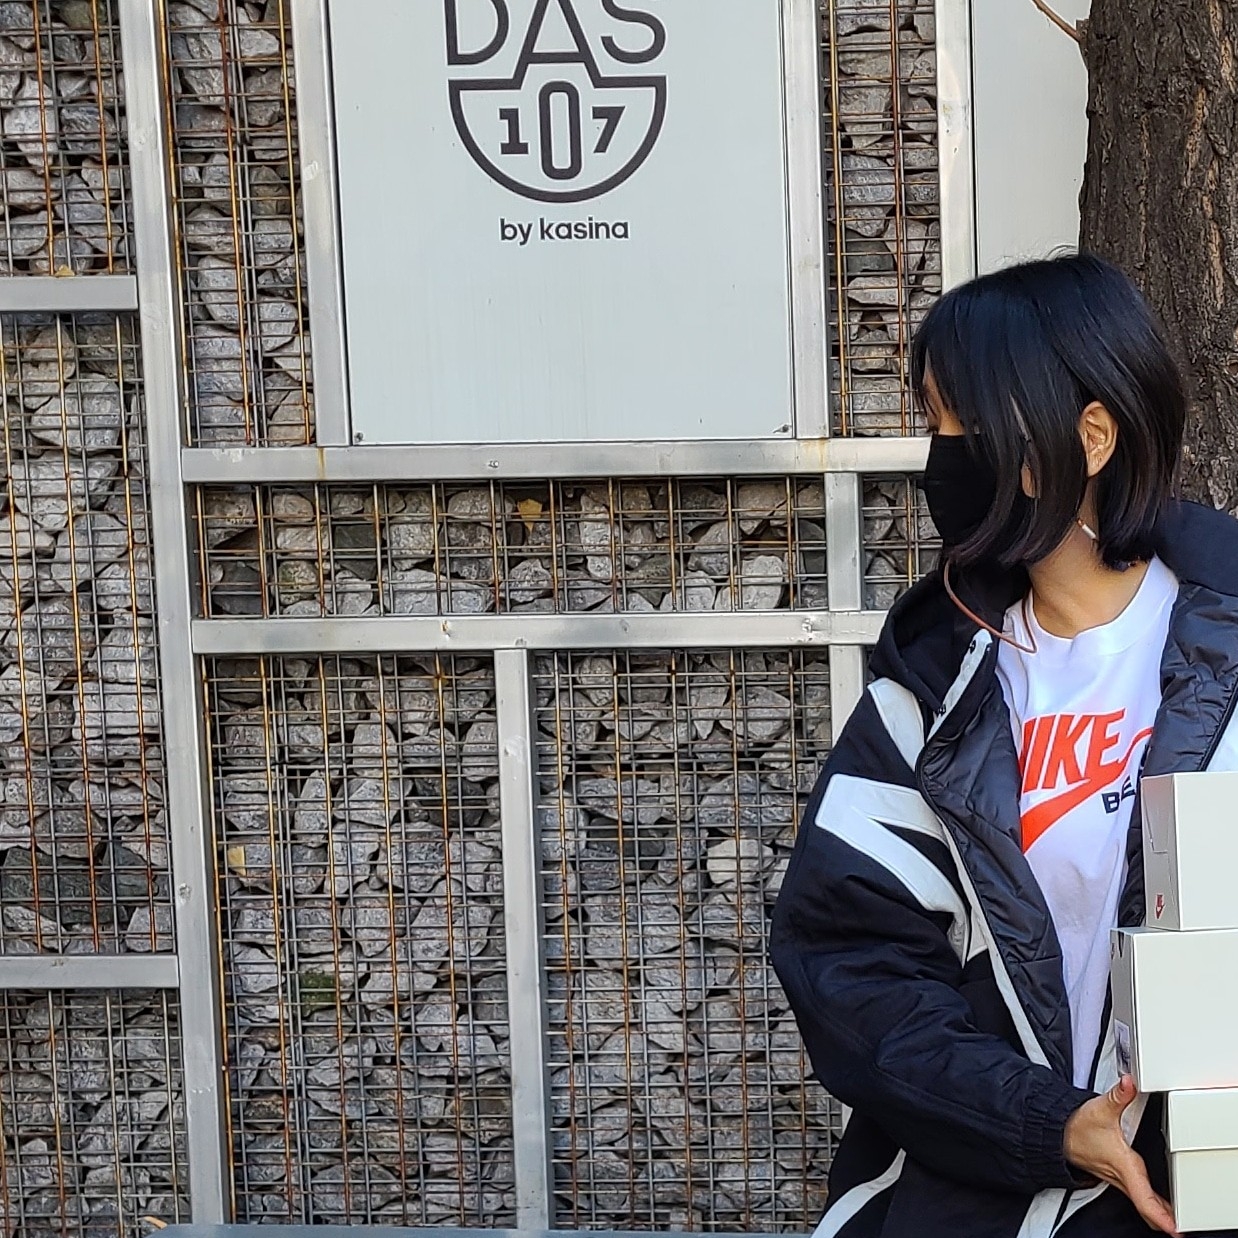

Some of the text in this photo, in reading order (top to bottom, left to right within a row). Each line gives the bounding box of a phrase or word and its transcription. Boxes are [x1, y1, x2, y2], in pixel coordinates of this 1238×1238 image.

[444, 0, 667, 68] DAS
[499, 80, 626, 180] 107
[500, 216, 629, 246] by kasina
